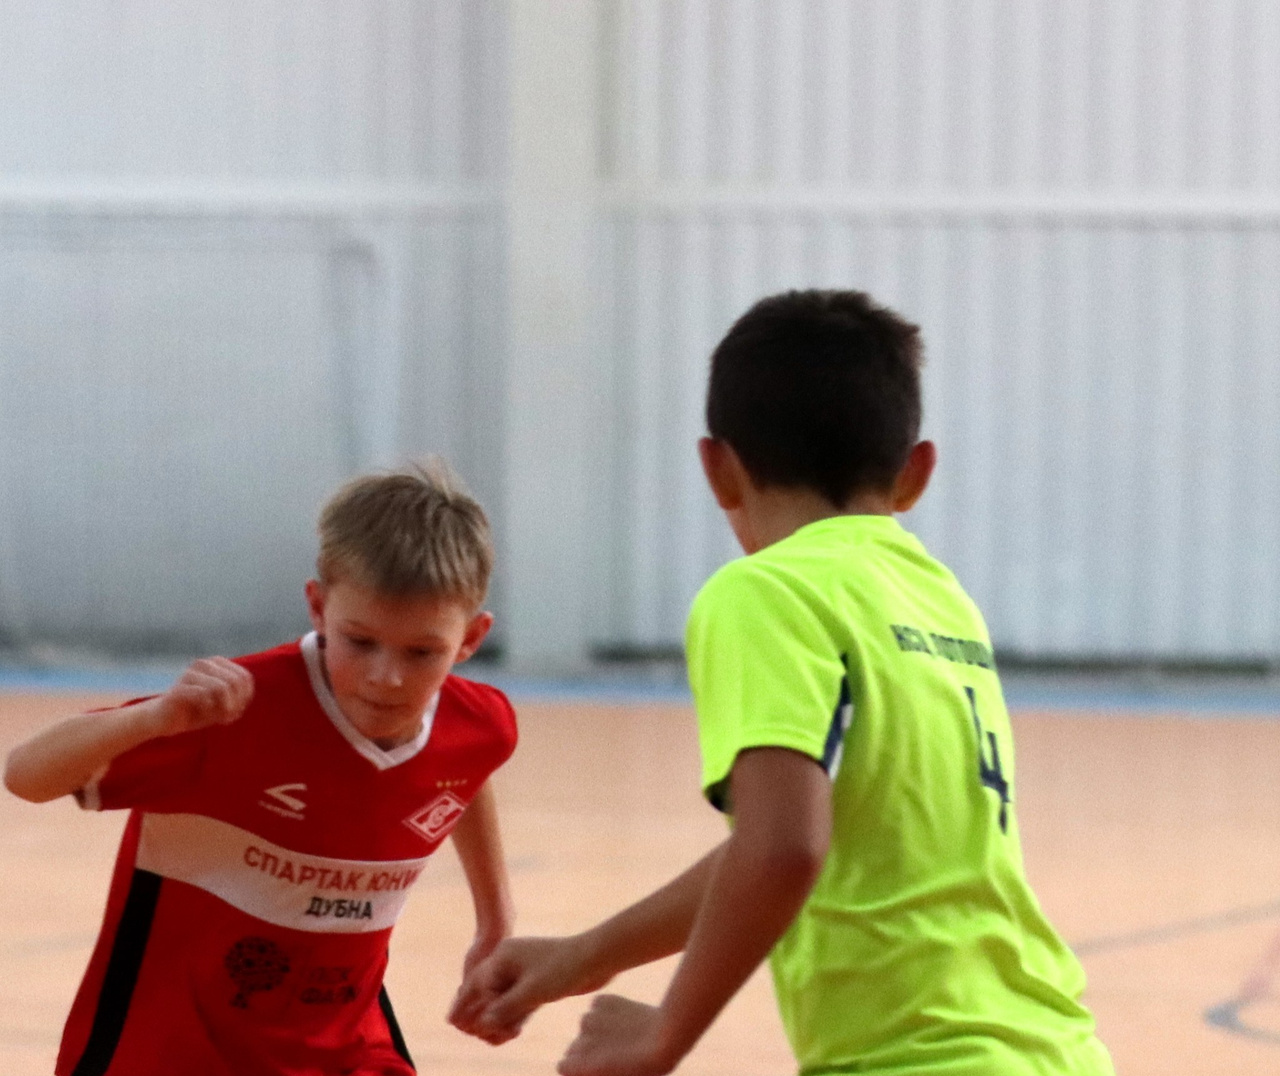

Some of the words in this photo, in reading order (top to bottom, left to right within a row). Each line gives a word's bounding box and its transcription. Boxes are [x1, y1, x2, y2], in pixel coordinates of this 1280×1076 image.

[964, 686, 1011, 834] 4
[244, 845, 365, 892] СПАРТАК
[305, 897, 373, 920] ДУБНА
